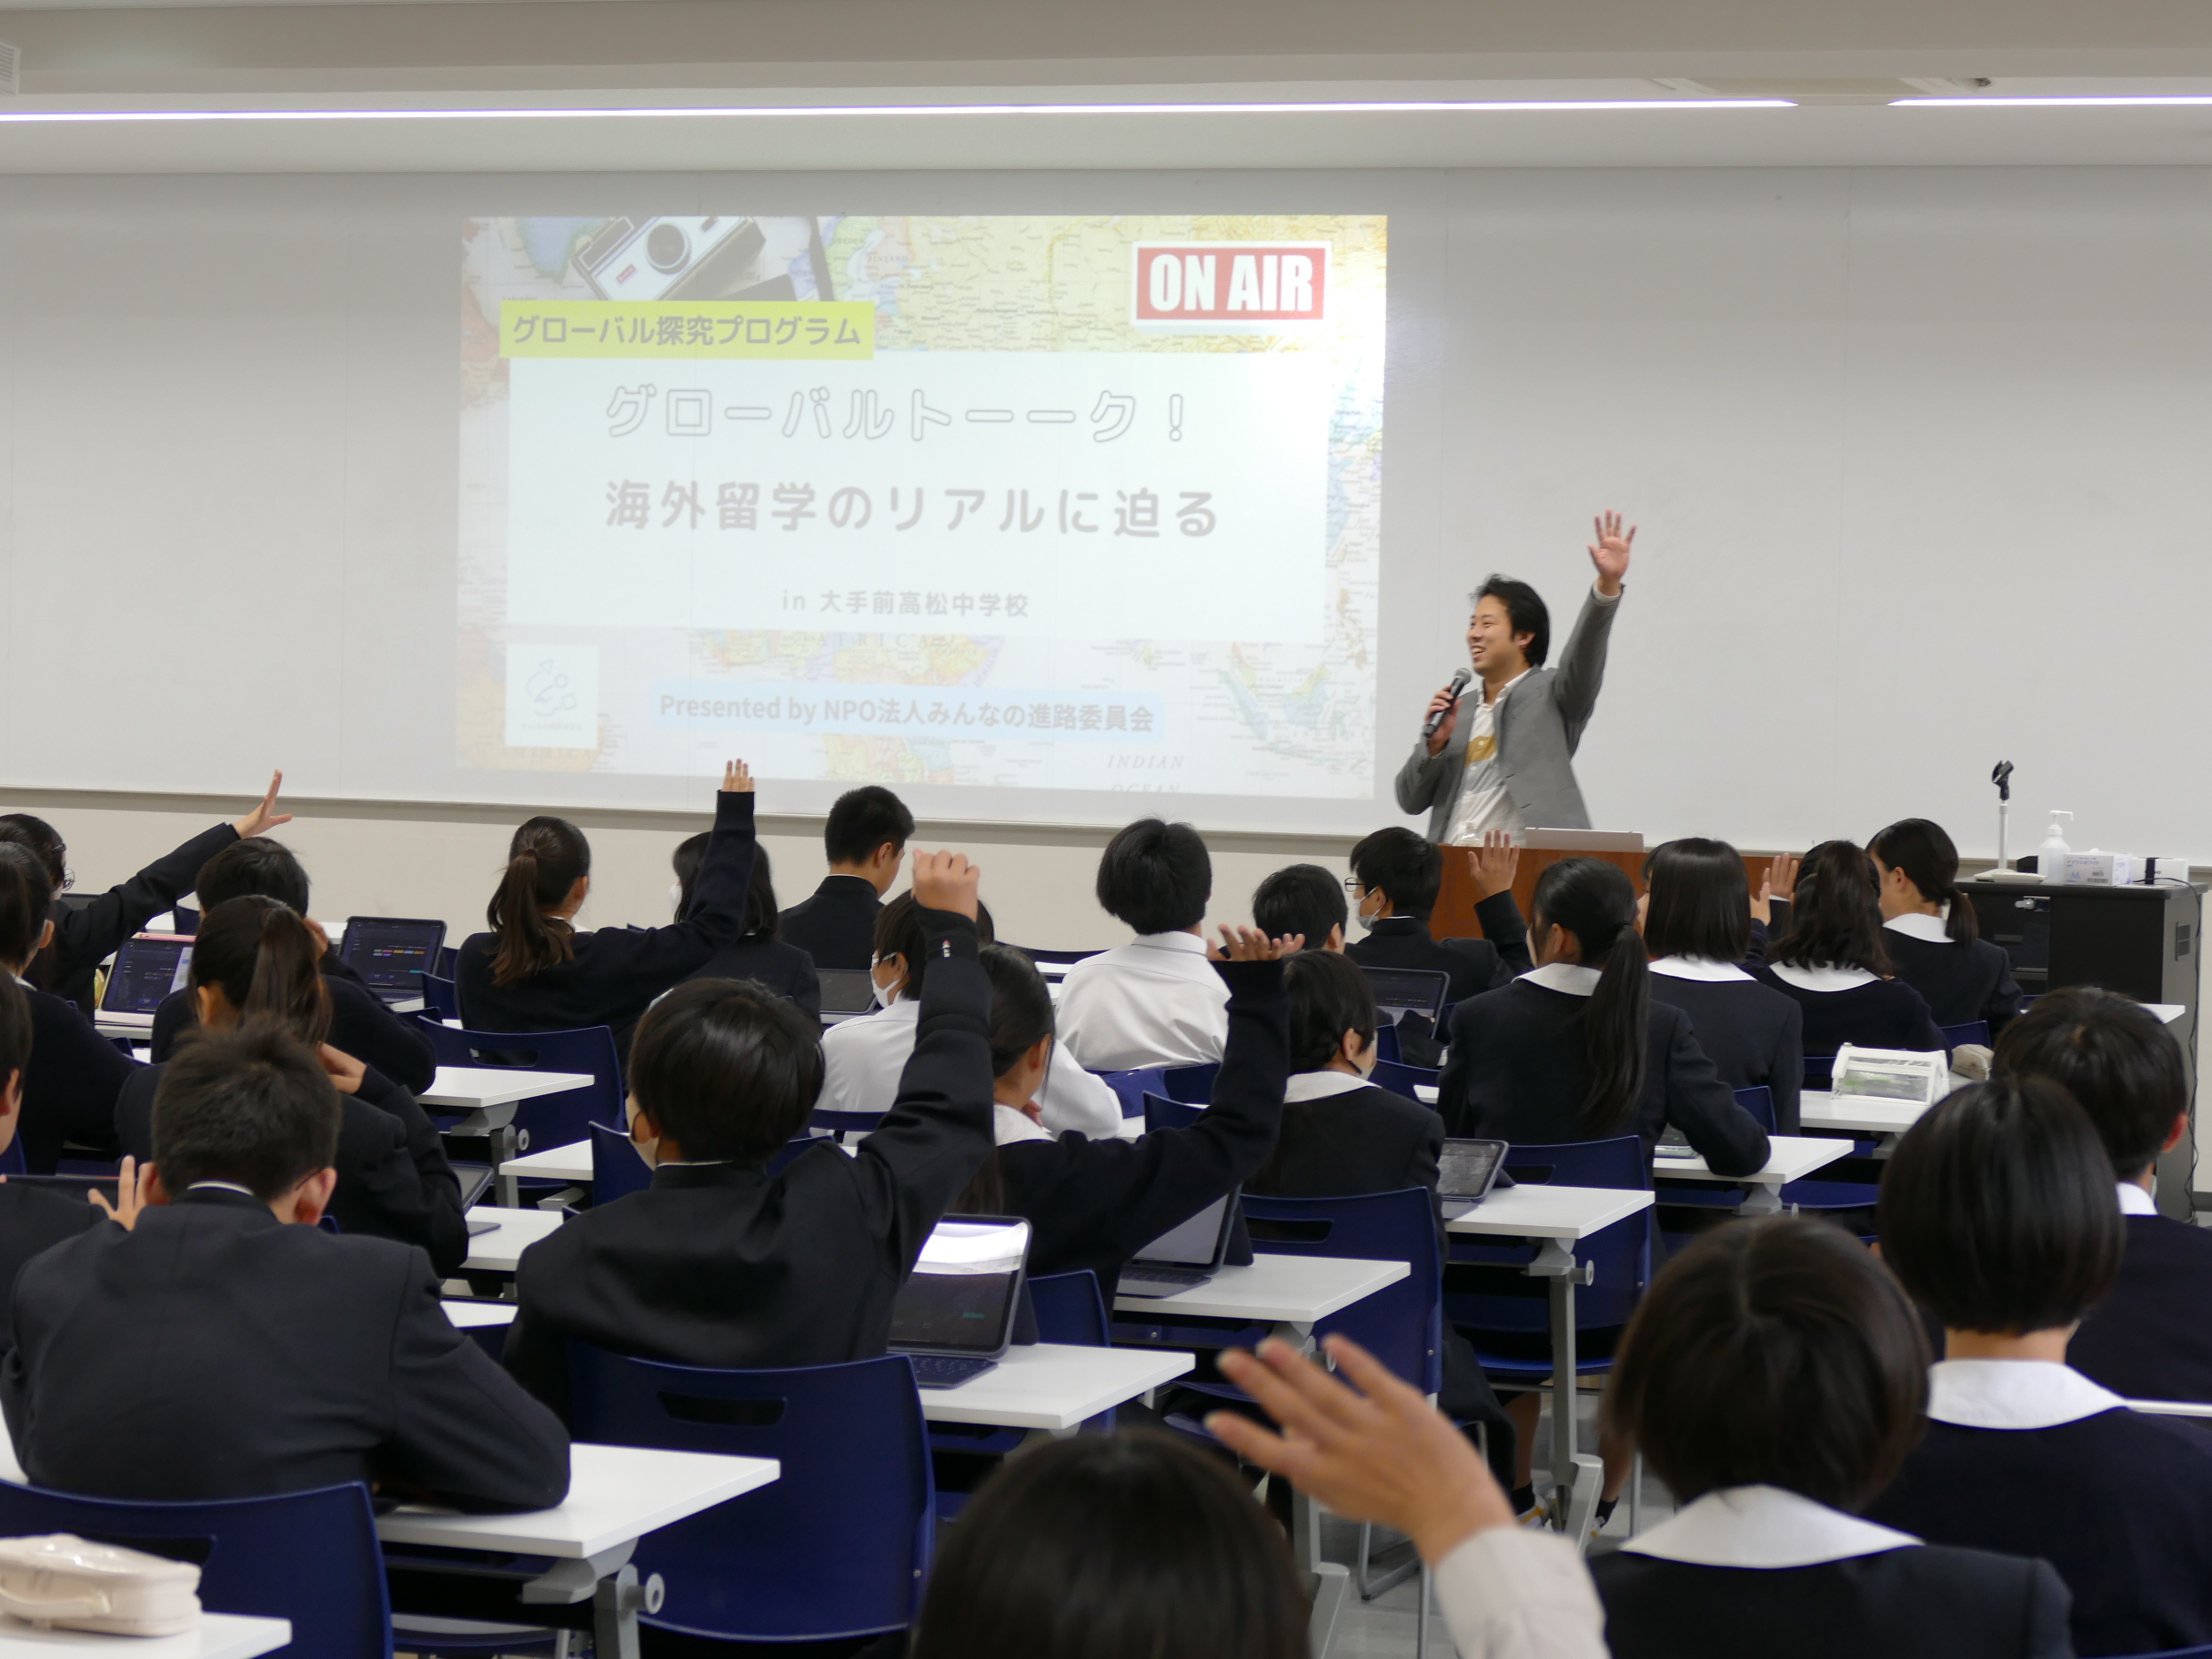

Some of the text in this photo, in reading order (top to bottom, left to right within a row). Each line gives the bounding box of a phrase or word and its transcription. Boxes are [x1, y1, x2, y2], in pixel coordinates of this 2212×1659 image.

[1149, 254, 1312, 312] ON AIR
[513, 315, 860, 346] グローバル探究プログラム
[606, 479, 1216, 537] 海外留学のリアルに迫る
[782, 589, 1029, 618] in 大手前高松中学校
[659, 694, 1154, 732] Presented by NPO法人みんなの進路委員会
[1106, 754, 1185, 769] INDIAN
